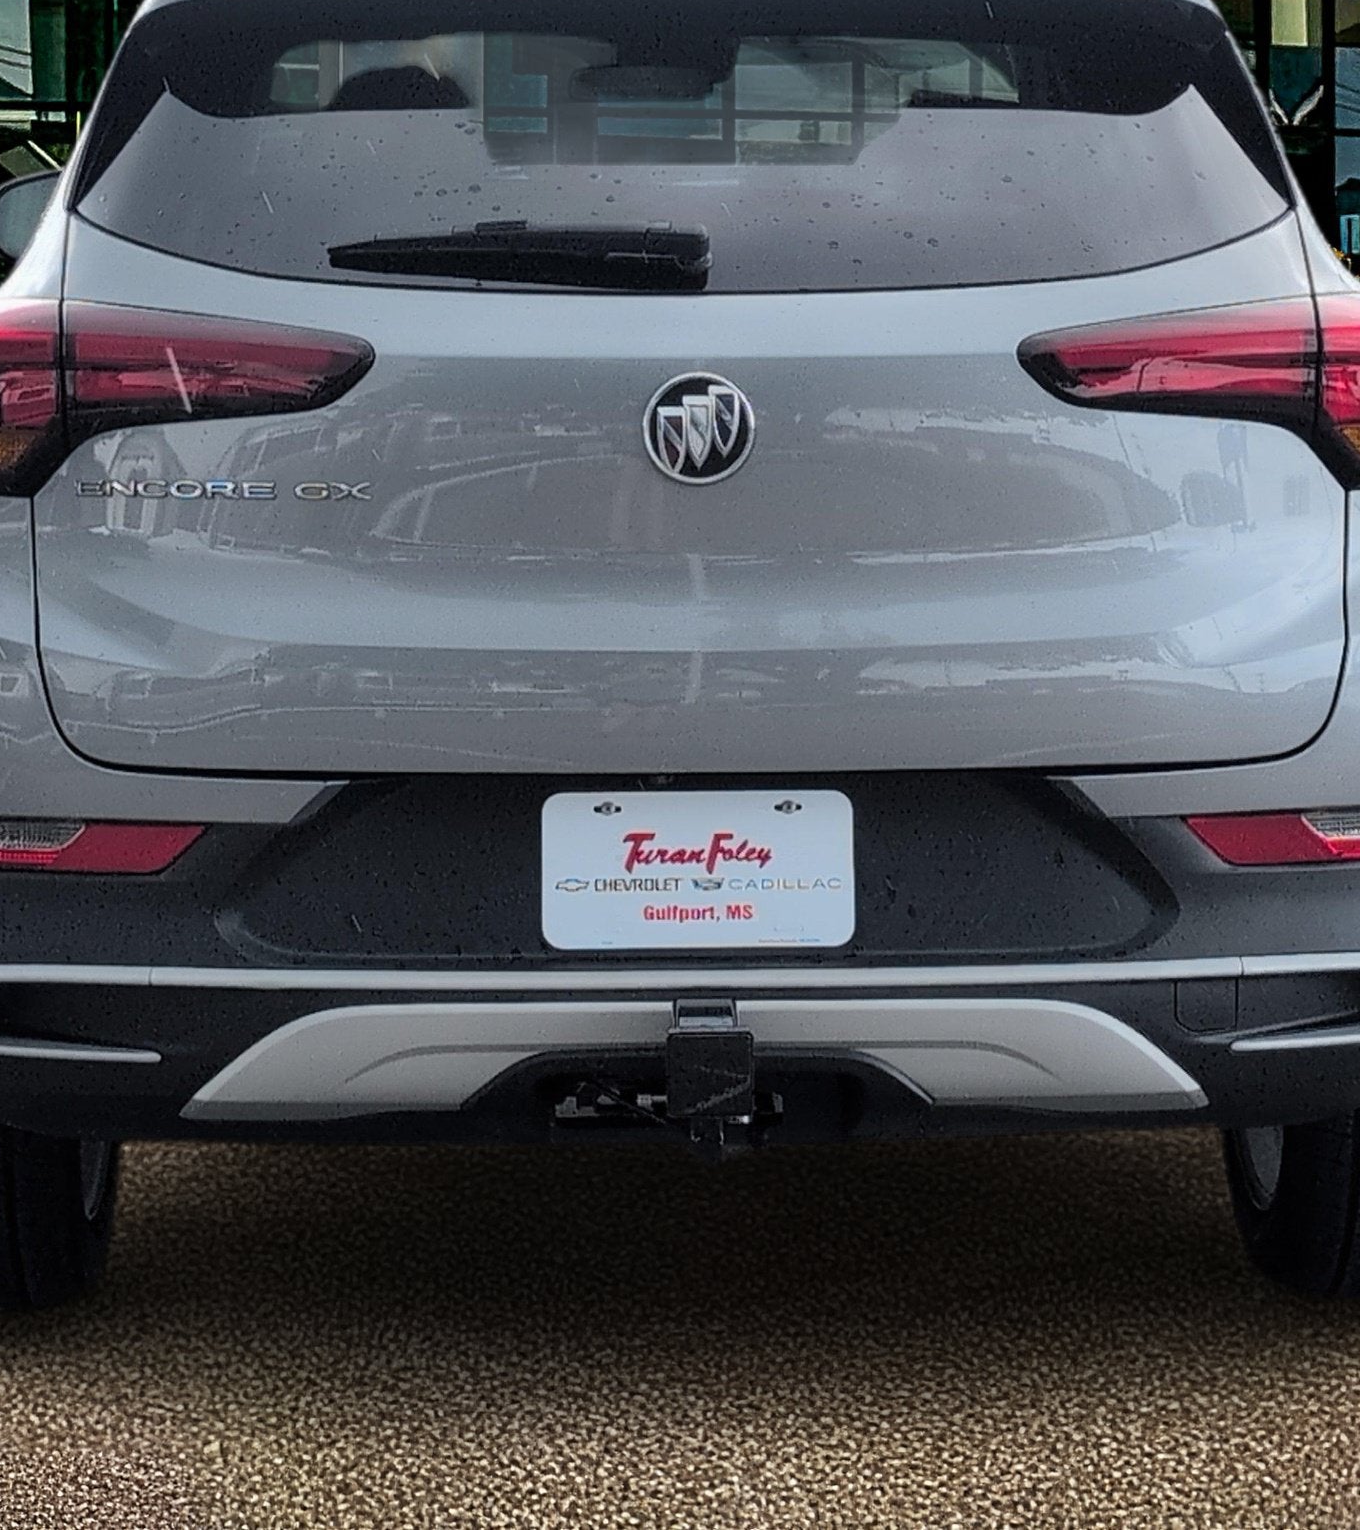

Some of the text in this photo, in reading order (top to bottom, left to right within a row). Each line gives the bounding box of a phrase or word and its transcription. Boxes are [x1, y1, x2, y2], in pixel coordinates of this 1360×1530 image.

[75, 478, 373, 500] ENCORE GX
[623, 832, 772, 874] Turan Foley
[594, 878, 841, 892] CHEVROLET CADILLAC
[644, 904, 753, 923] Gulfport, MS
